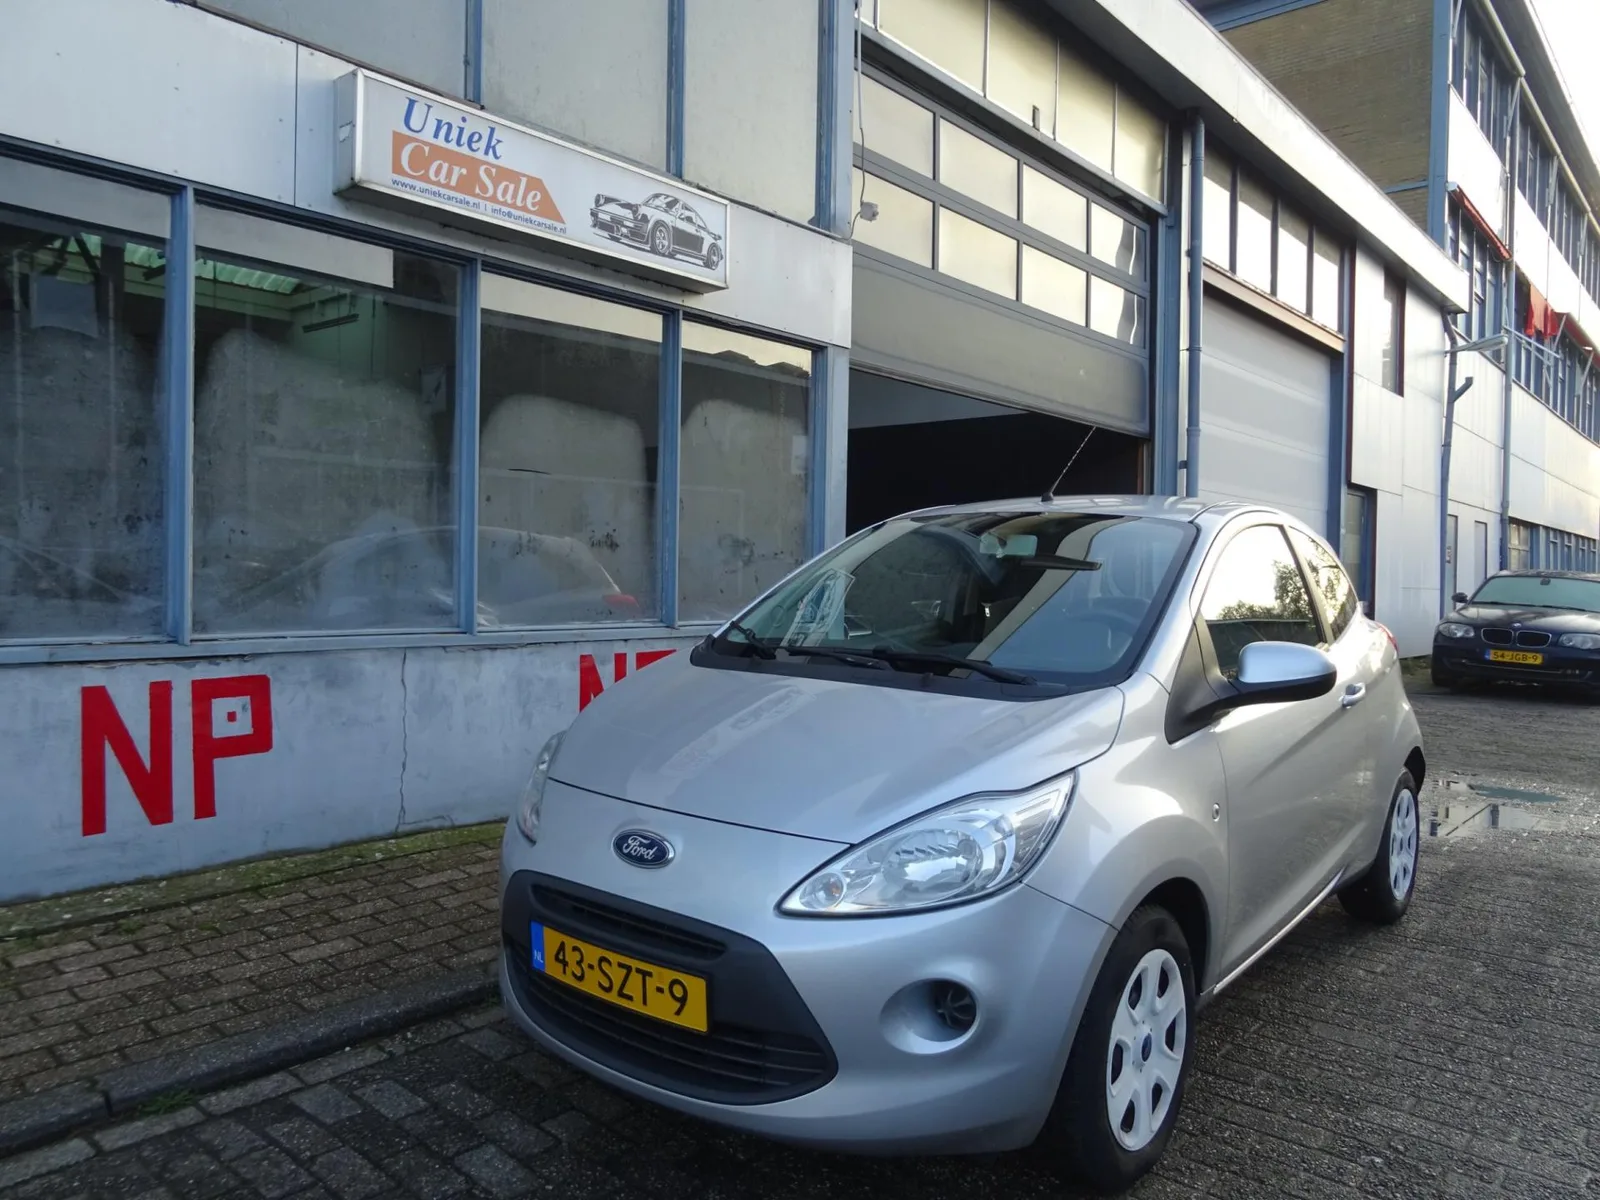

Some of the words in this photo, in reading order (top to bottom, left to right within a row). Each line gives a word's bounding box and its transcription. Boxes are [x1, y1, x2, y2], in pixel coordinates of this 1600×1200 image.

[403, 97, 503, 160] Uniek
[391, 177, 481, 210] www.uniekcarsale.nl
[491, 207, 567, 235] info@uniekcarsale.nl
[400, 141, 468, 188] Car
[475, 164, 543, 212] Sale
[1493, 651, 1538, 662] 54-JGB-9
[80, 674, 274, 838] NP
[622, 835, 657, 861] Ford
[533, 948, 544, 964] NL
[554, 940, 689, 1017] 43-SZT-9
